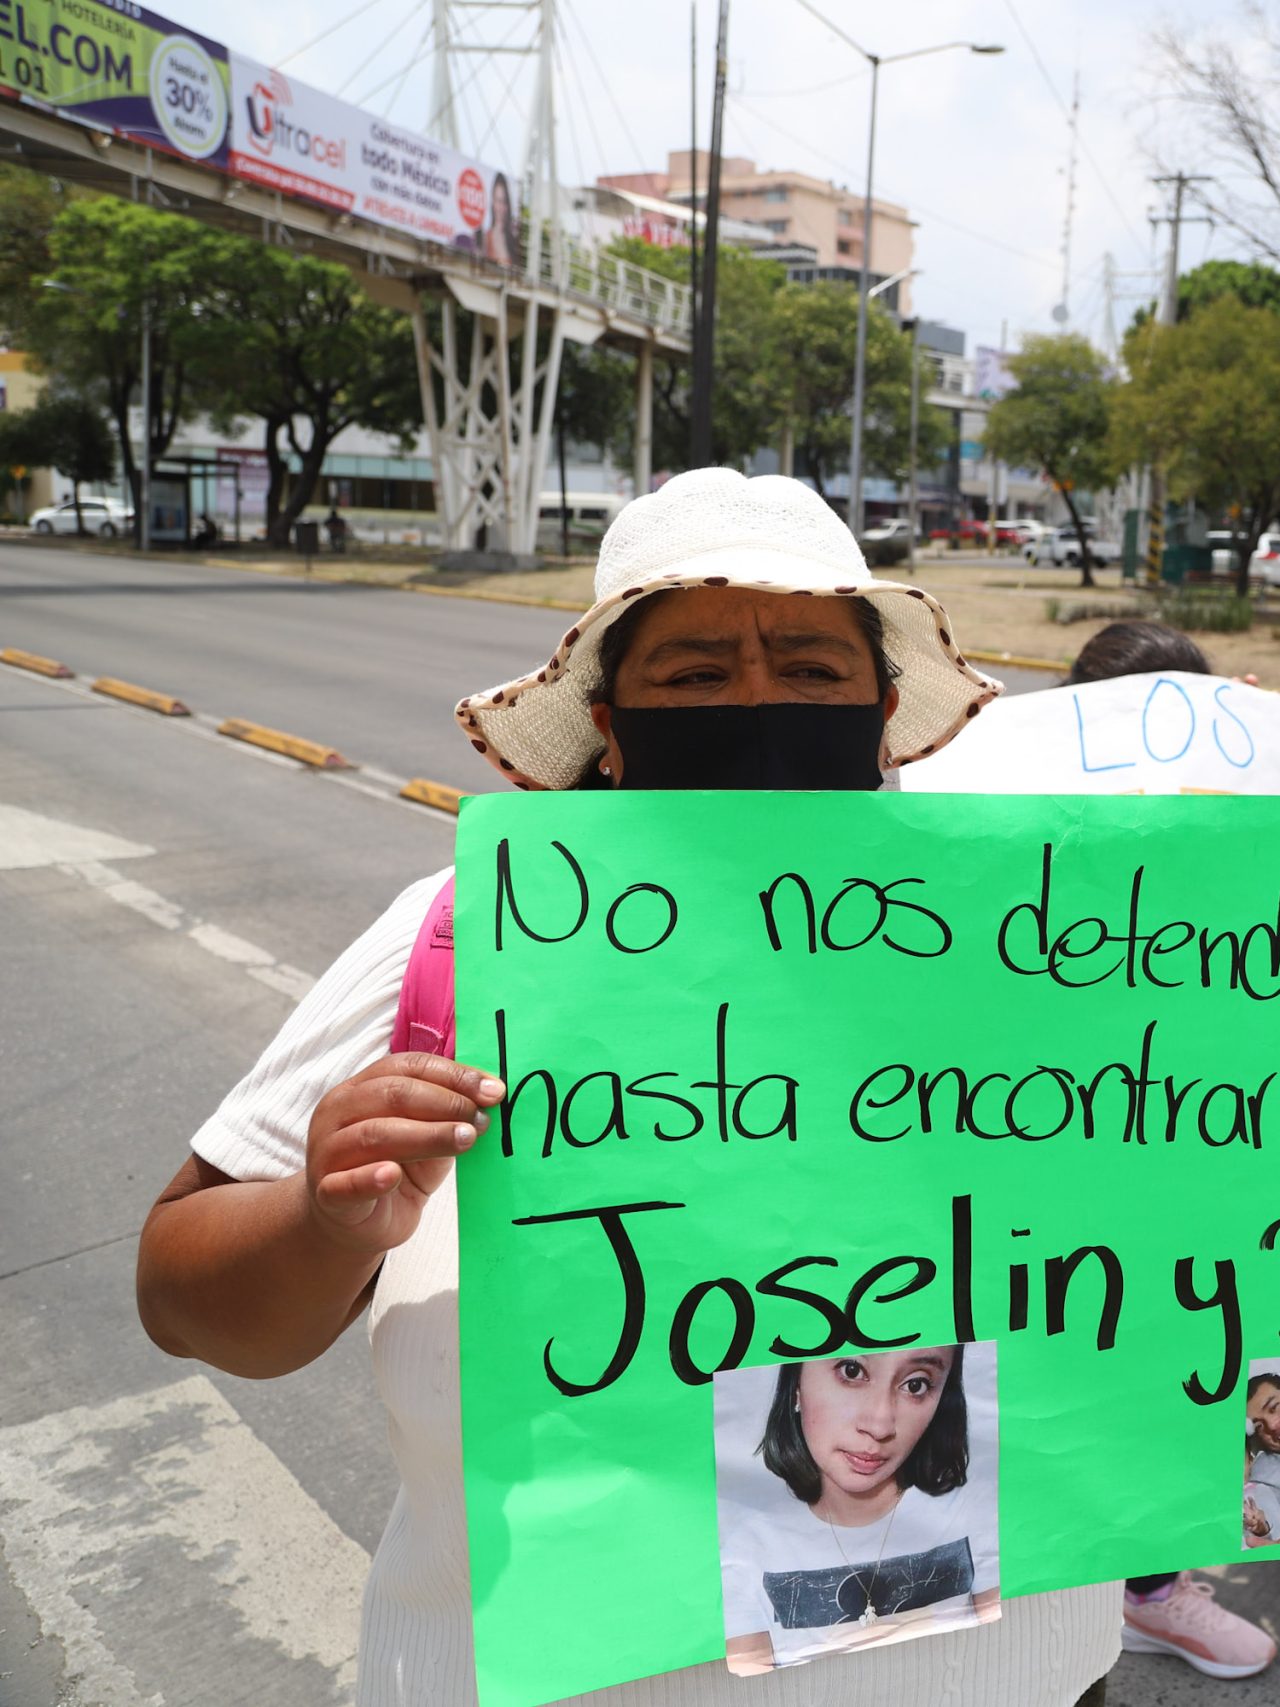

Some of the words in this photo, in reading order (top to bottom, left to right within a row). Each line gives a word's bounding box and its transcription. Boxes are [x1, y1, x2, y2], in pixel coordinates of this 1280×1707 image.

[166, 78, 213, 122] 30%
[1073, 678, 1255, 772] LOS
[496, 839, 677, 953] No
[759, 873, 953, 957] nos
[497, 1003, 800, 1159] hasta
[512, 1194, 1123, 1398] Joselin
[1175, 1257, 1242, 1406] y
